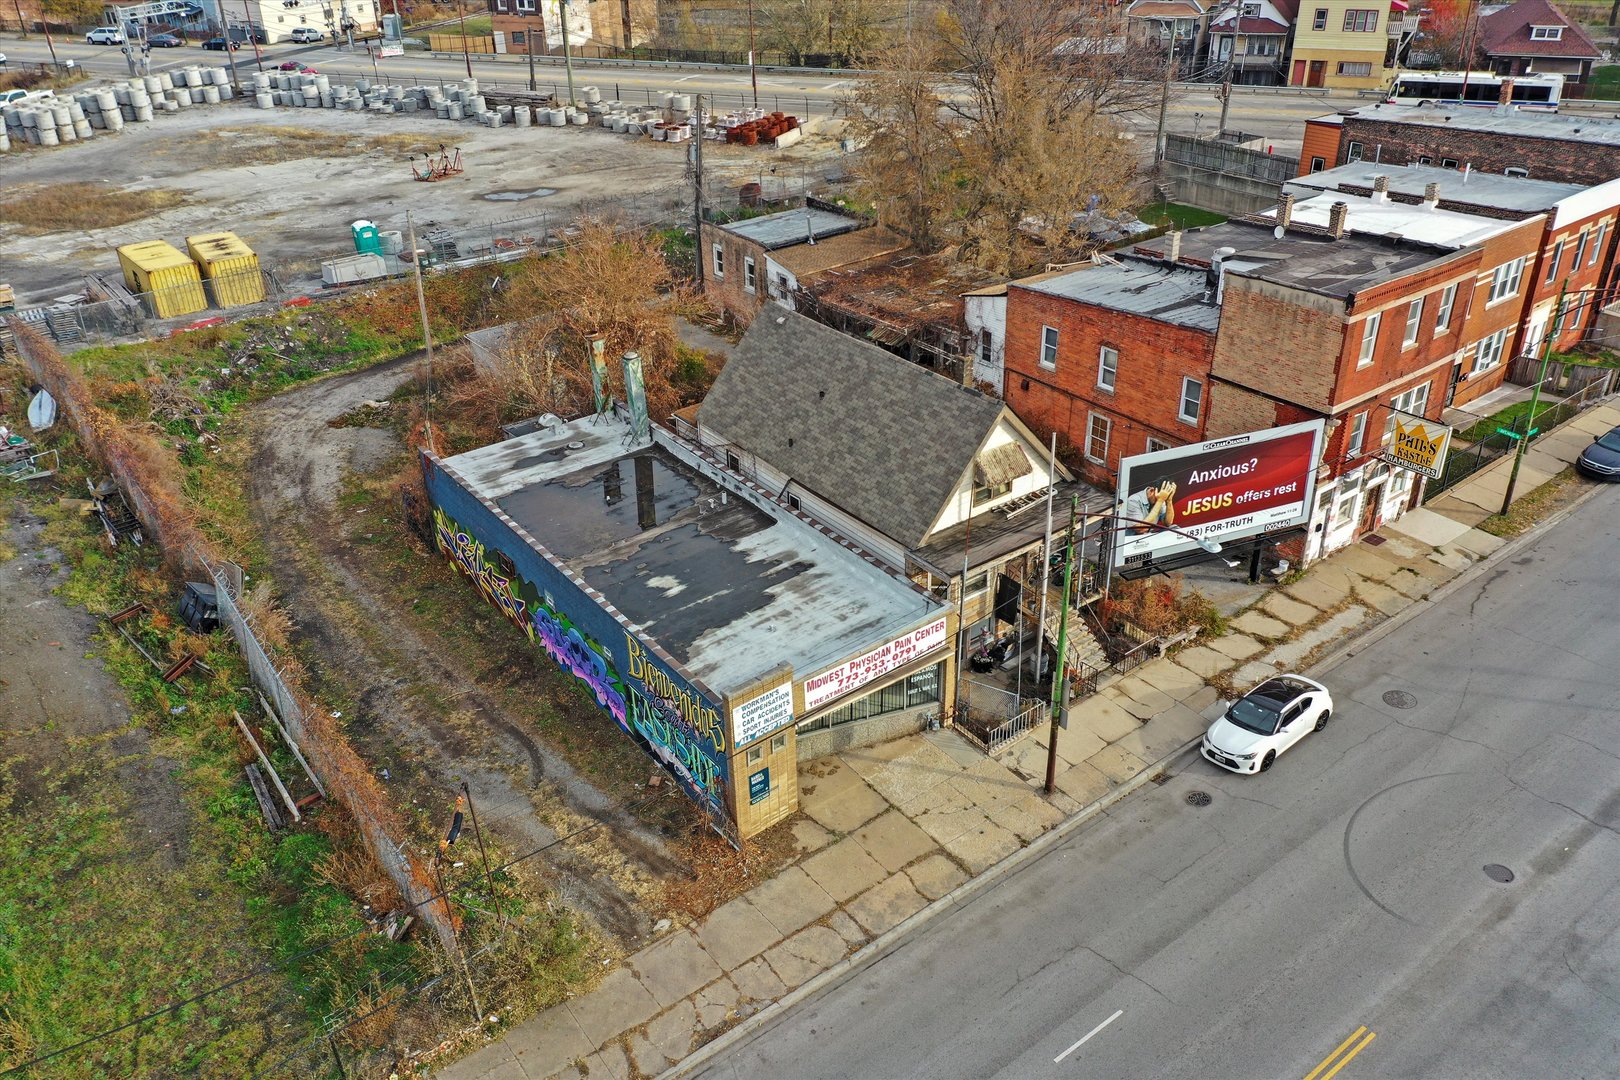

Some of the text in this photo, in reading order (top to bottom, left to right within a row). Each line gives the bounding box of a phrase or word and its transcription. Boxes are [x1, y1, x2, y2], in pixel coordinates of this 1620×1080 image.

[1397, 447, 1432, 467] KASTLE
[1398, 432, 1437, 456] PHIL'S
[1188, 458, 1258, 485] Anxious?
[1387, 454, 1436, 476] HAMBURGERS
[1182, 481, 1297, 516] JESUS offers rest
[1204, 516, 1254, 534] FOR-TRUTH
[806, 621, 945, 693] MIDWEST PHYSICIAN PAIN CENTER
[837, 644, 917, 687] 773-933-0791
[622, 629, 726, 754] Bienvenidos
[809, 682, 855, 707] TREATMENT
[859, 676, 868, 684] OF
[872, 666, 889, 679] ANY
[893, 656, 911, 668] TYPE
[741, 689, 780, 711] WORKMAN'S
[741, 691, 790, 719] COMPENSATION
[742, 699, 790, 727] CAR ACCIDENTS
[742, 708, 788, 735] SPORT INJURIES
